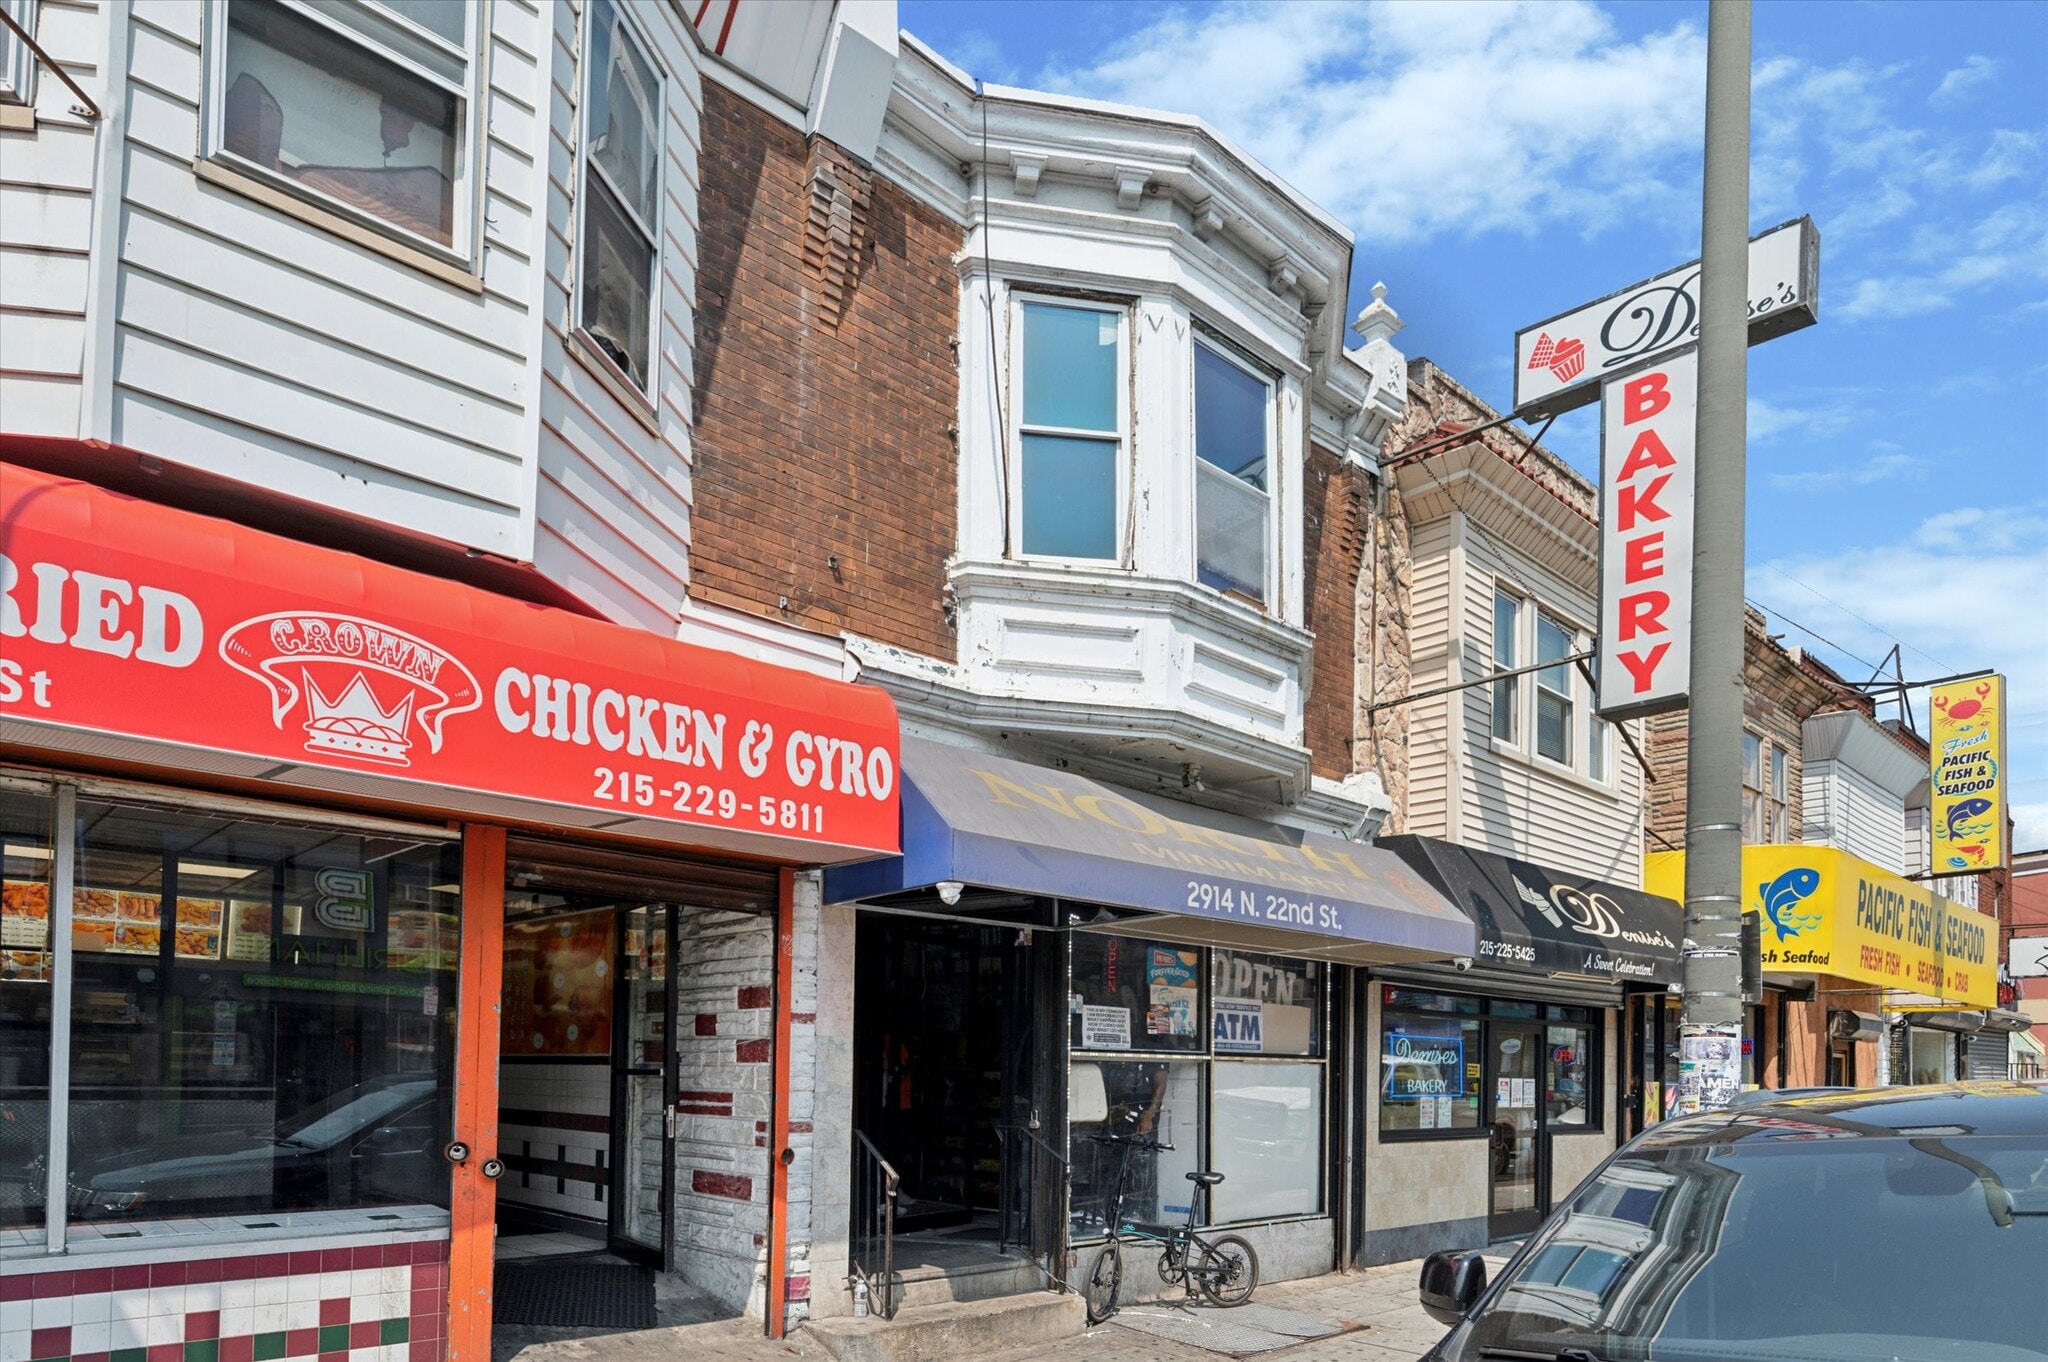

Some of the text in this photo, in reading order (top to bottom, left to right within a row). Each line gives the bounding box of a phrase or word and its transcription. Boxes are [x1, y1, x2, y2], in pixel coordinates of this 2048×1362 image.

[1600, 271, 1797, 368] Dese's
[1616, 371, 1678, 694] BAKERY
[270, 618, 447, 685] CROWN
[494, 667, 893, 801] CHICKEN & GYRO
[1941, 729, 1988, 755] Fresh
[1942, 750, 1990, 767] PACIFIC
[1937, 779, 1994, 796] SEAFOOD
[1944, 765, 1986, 781] FISH &
[593, 767, 823, 833] 215-229-5811
[1130, 840, 1352, 893] MINIMART
[1187, 881, 1342, 931] 2914 N. 22nd St.
[1550, 884, 1675, 949] Denise's
[1857, 878, 1985, 965] PACIFIC FISH & SEAFOOD
[1480, 940, 1535, 961] 215-225-5425
[1583, 953, 1655, 976] A Sweet Celebration!
[1782, 950, 1830, 965] Seafood
[1860, 944, 1883, 973] FRESH
[1885, 951, 1901, 977] FISH
[1917, 960, 1944, 988] SEAFOOD
[1954, 971, 1968, 993] CRAB
[1214, 1013, 1260, 1041] ATM
[1407, 1079, 1448, 1093] BAKERY
